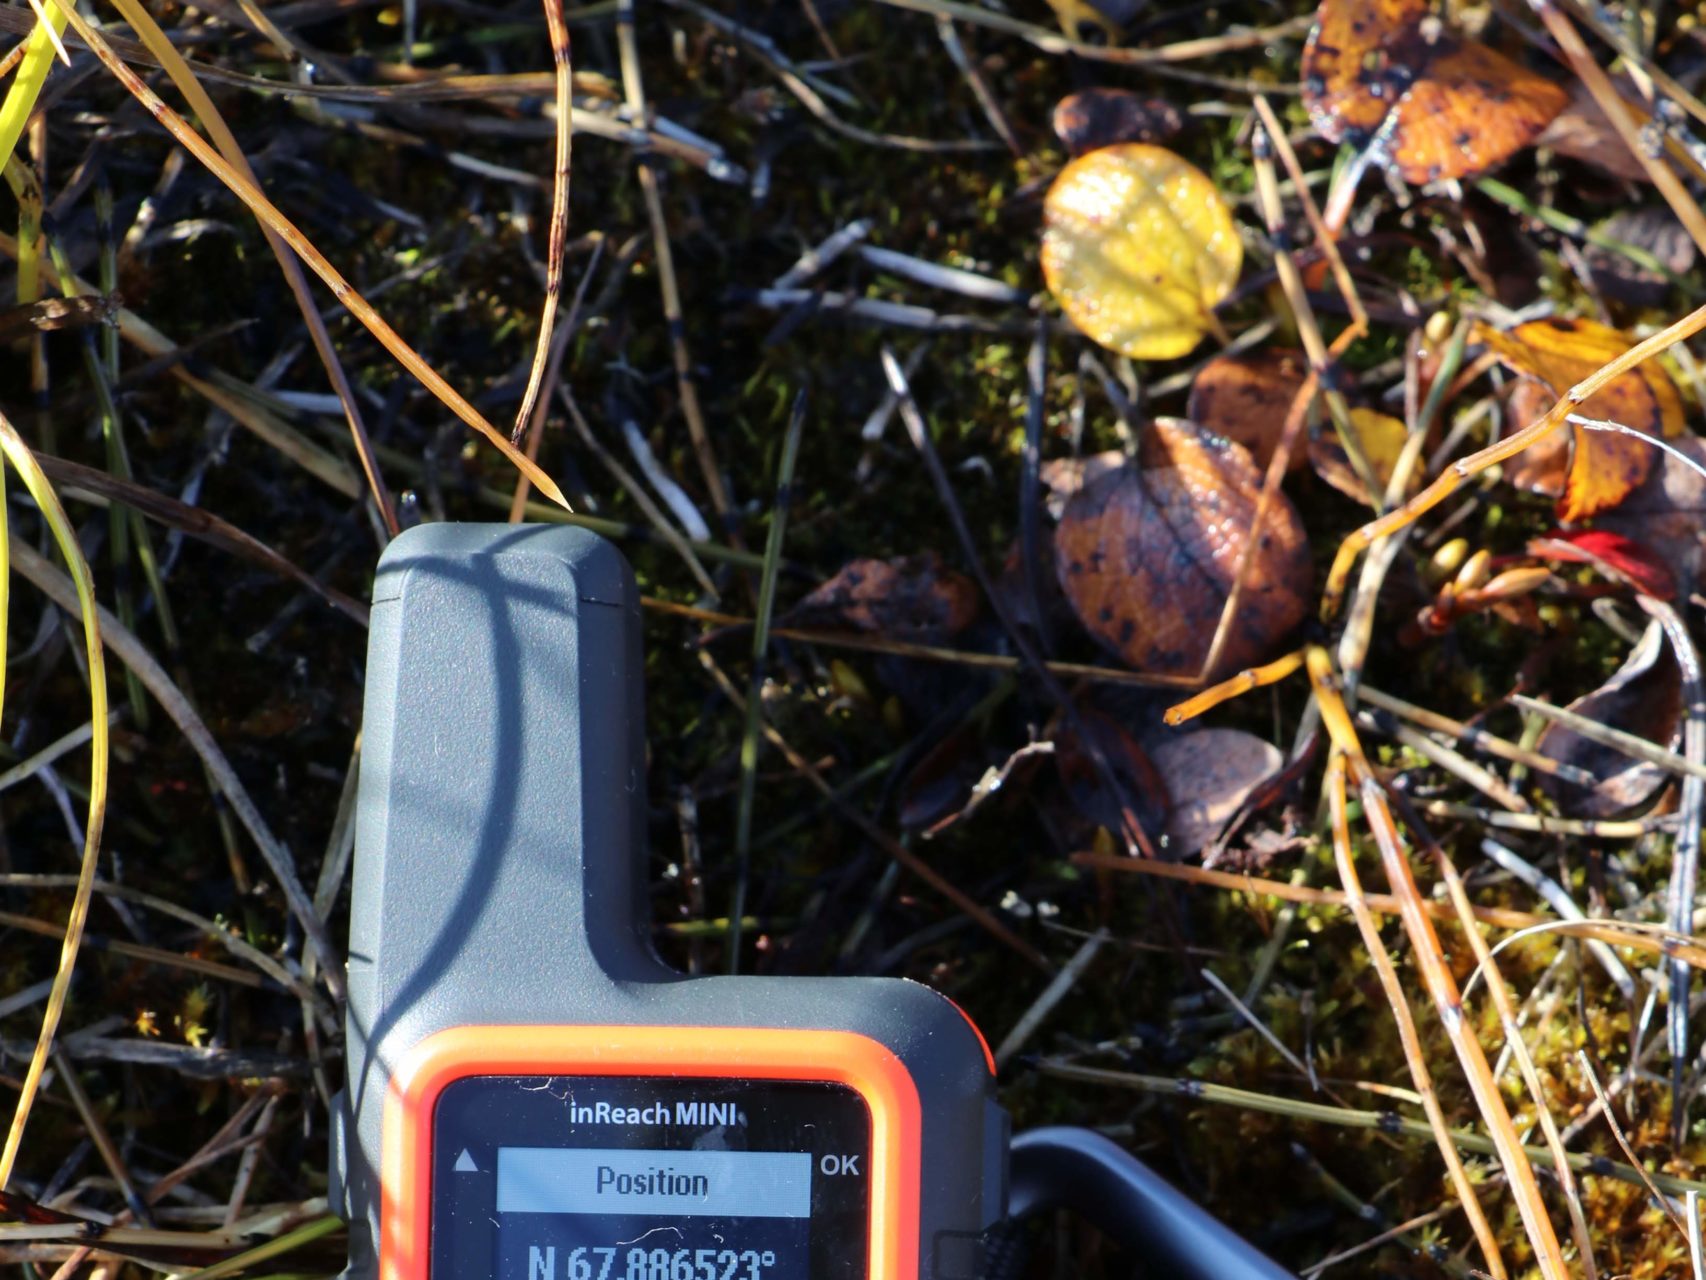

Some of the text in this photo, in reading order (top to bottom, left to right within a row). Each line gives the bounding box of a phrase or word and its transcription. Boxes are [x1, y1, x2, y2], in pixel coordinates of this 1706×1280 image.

[571, 1102, 737, 1126] inReach MINI
[820, 1155, 860, 1176] OK
[596, 1166, 709, 1197] Position
